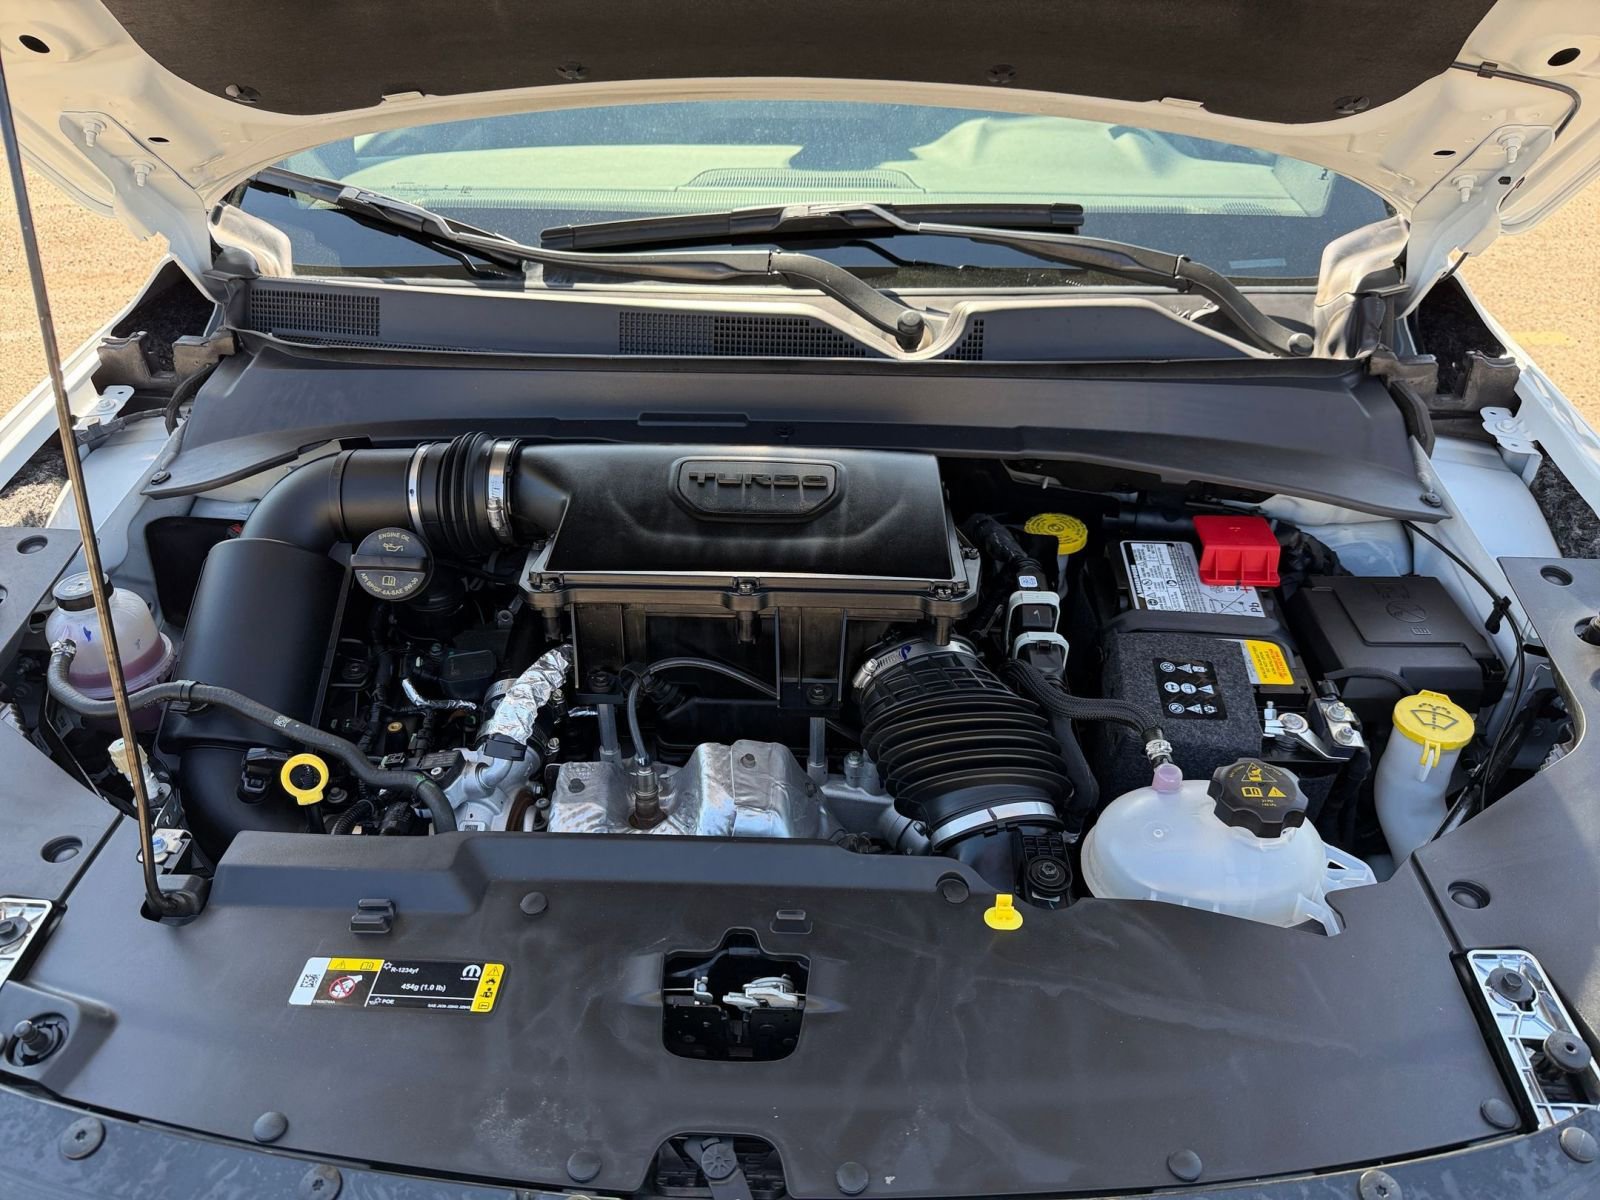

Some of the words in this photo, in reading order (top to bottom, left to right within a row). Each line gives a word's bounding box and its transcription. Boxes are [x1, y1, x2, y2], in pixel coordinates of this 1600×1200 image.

[688, 471, 828, 488] TURBO
[378, 532, 400, 540] ENGINE
[400, 534, 410, 542] OIL
[1248, 602, 1262, 613] Pb
[390, 966, 420, 974] R-1234yf
[400, 983, 420, 991] 454g
[420, 983, 434, 992] (1.0
[435, 984, 447, 992] lb)
